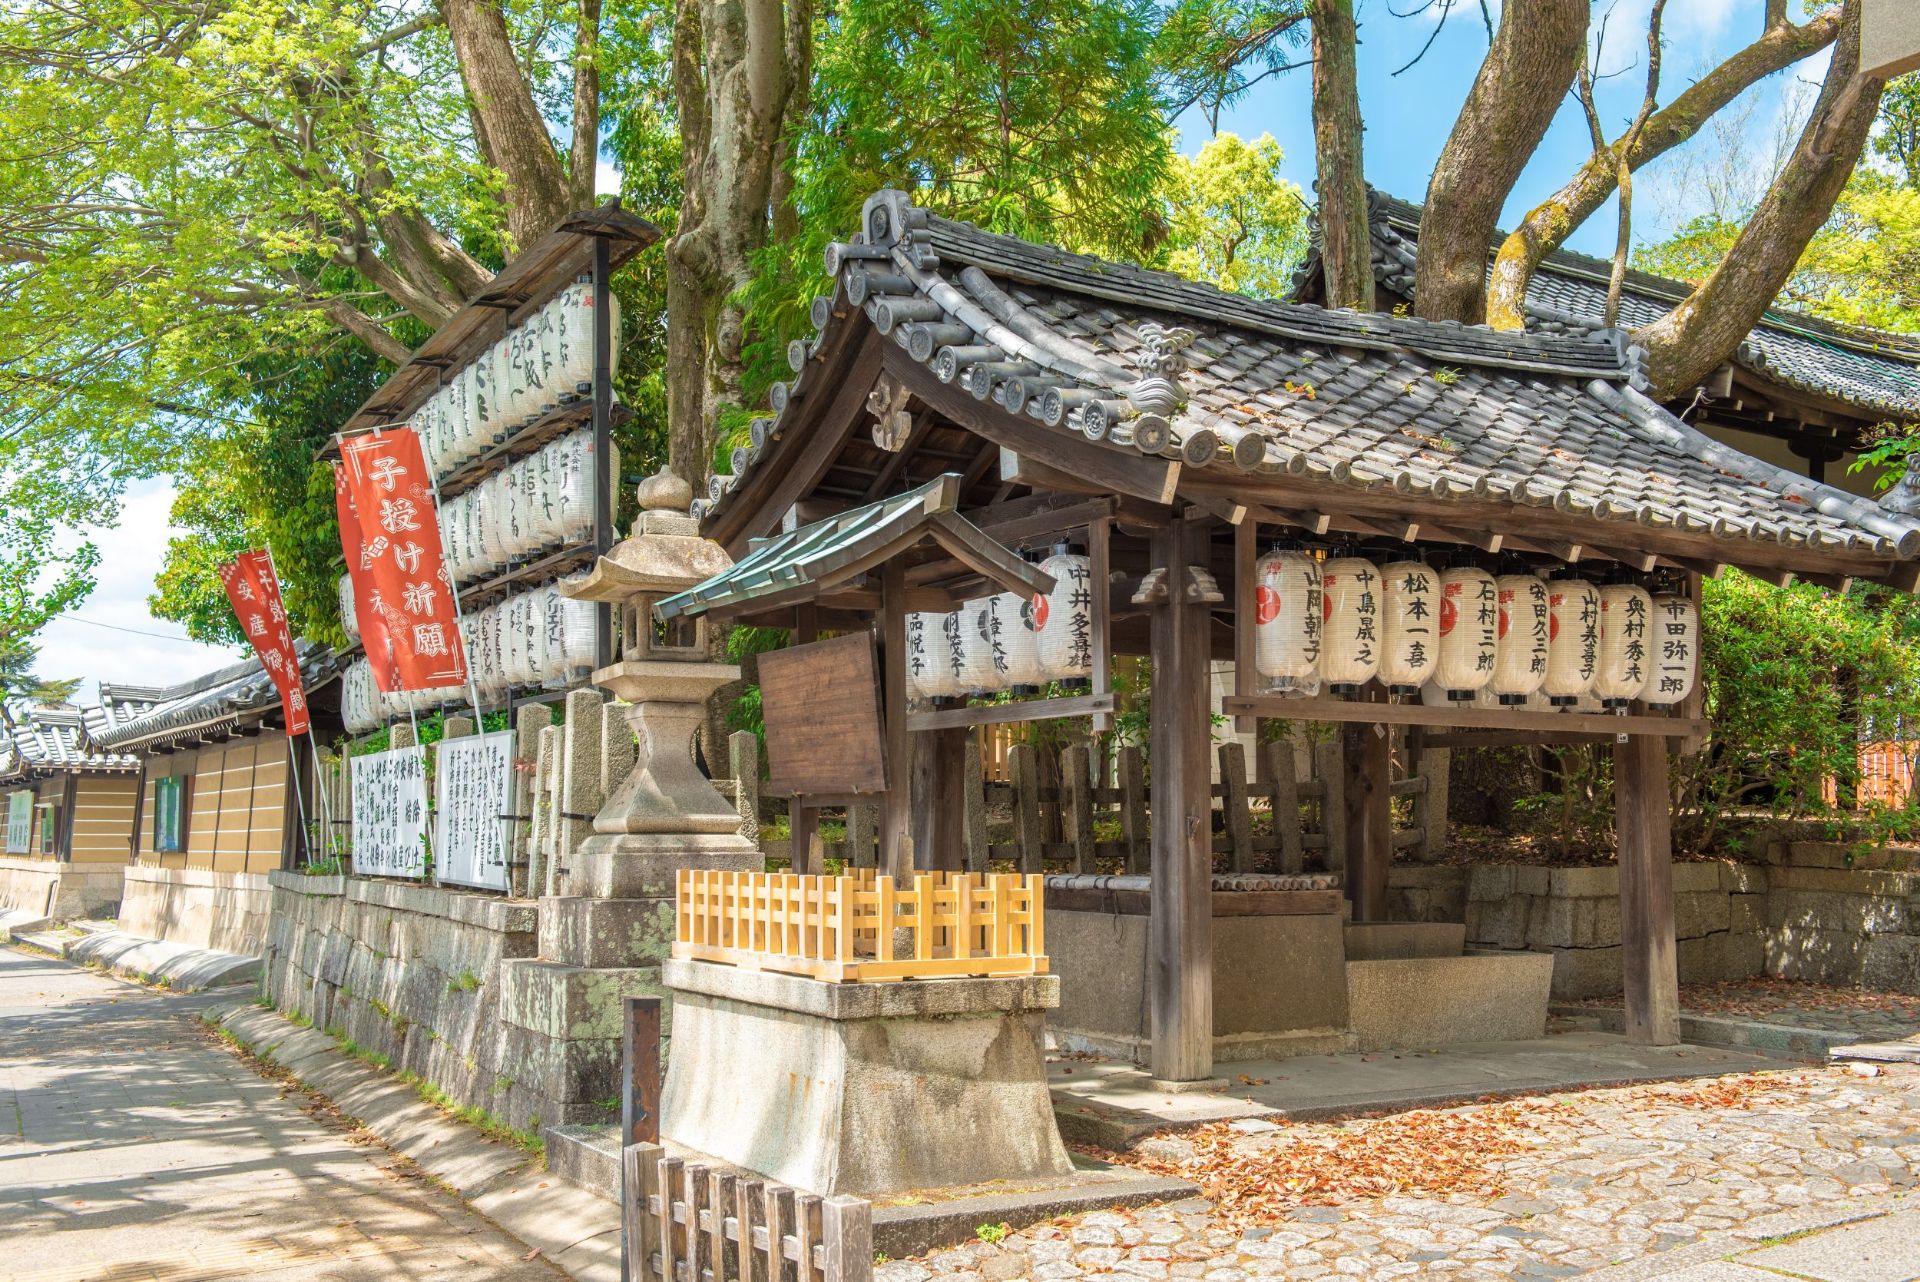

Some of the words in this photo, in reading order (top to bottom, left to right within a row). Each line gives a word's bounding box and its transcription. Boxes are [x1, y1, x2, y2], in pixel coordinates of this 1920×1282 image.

[368, 455, 449, 657] 子授け祈願
[547, 592, 559, 645] クリエイト
[1067, 565, 1092, 669] 中井多喜雄
[1303, 563, 1322, 664] 山岡朝子
[1402, 572, 1430, 668] 松本一喜
[1475, 579, 1497, 676] 石村三郎
[1529, 582, 1548, 679] 安田久三郎
[1580, 588, 1599, 681] 山村美喜子
[1621, 595, 1647, 683] 奥村秀夫
[1658, 600, 1689, 696] 市田弥一郎
